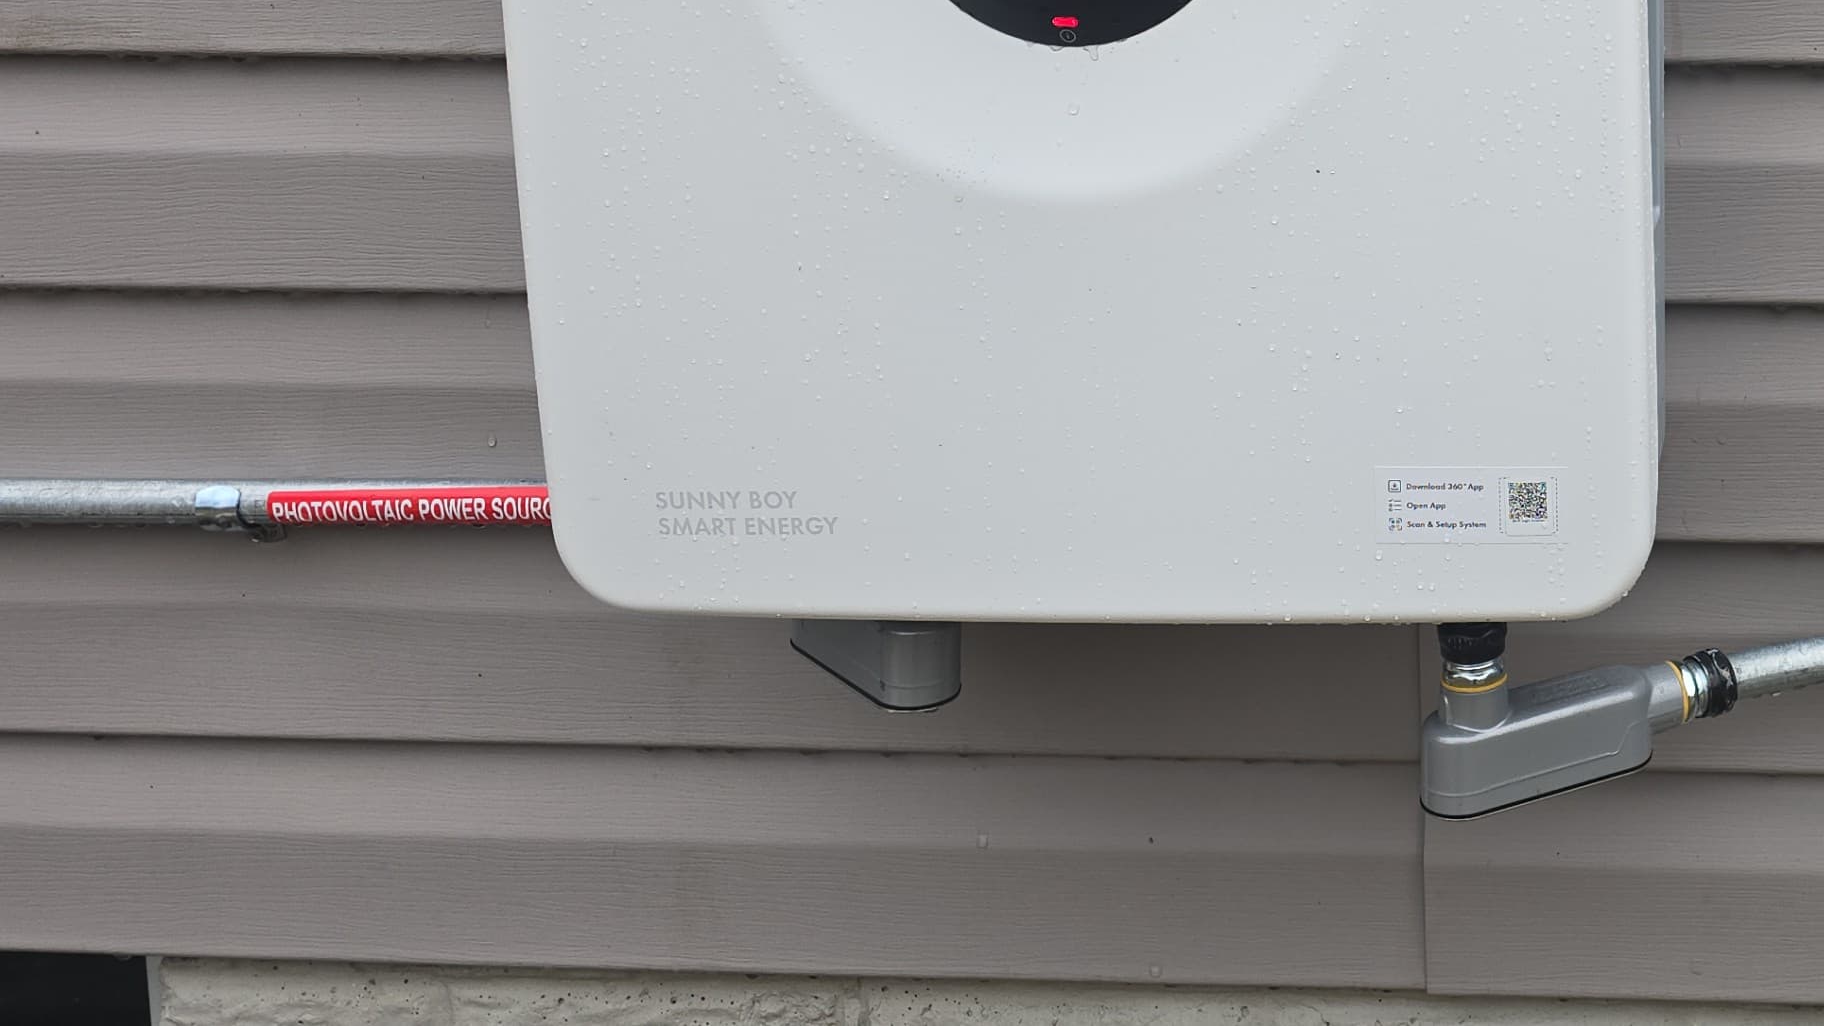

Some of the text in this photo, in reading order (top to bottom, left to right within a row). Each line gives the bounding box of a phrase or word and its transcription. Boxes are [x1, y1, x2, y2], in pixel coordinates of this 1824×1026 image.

[1406, 482, 1446, 491] Download
[1467, 483, 1484, 493] App
[655, 490, 796, 510] SUNNY BOY
[1406, 502, 1446, 511] Open App
[271, 498, 413, 523] PHOTOVOLTAIC
[417, 498, 486, 521] POWER
[658, 516, 839, 537] SMART ENERGY
[1435, 520, 1457, 530] Setup
[1459, 520, 1487, 530] System
